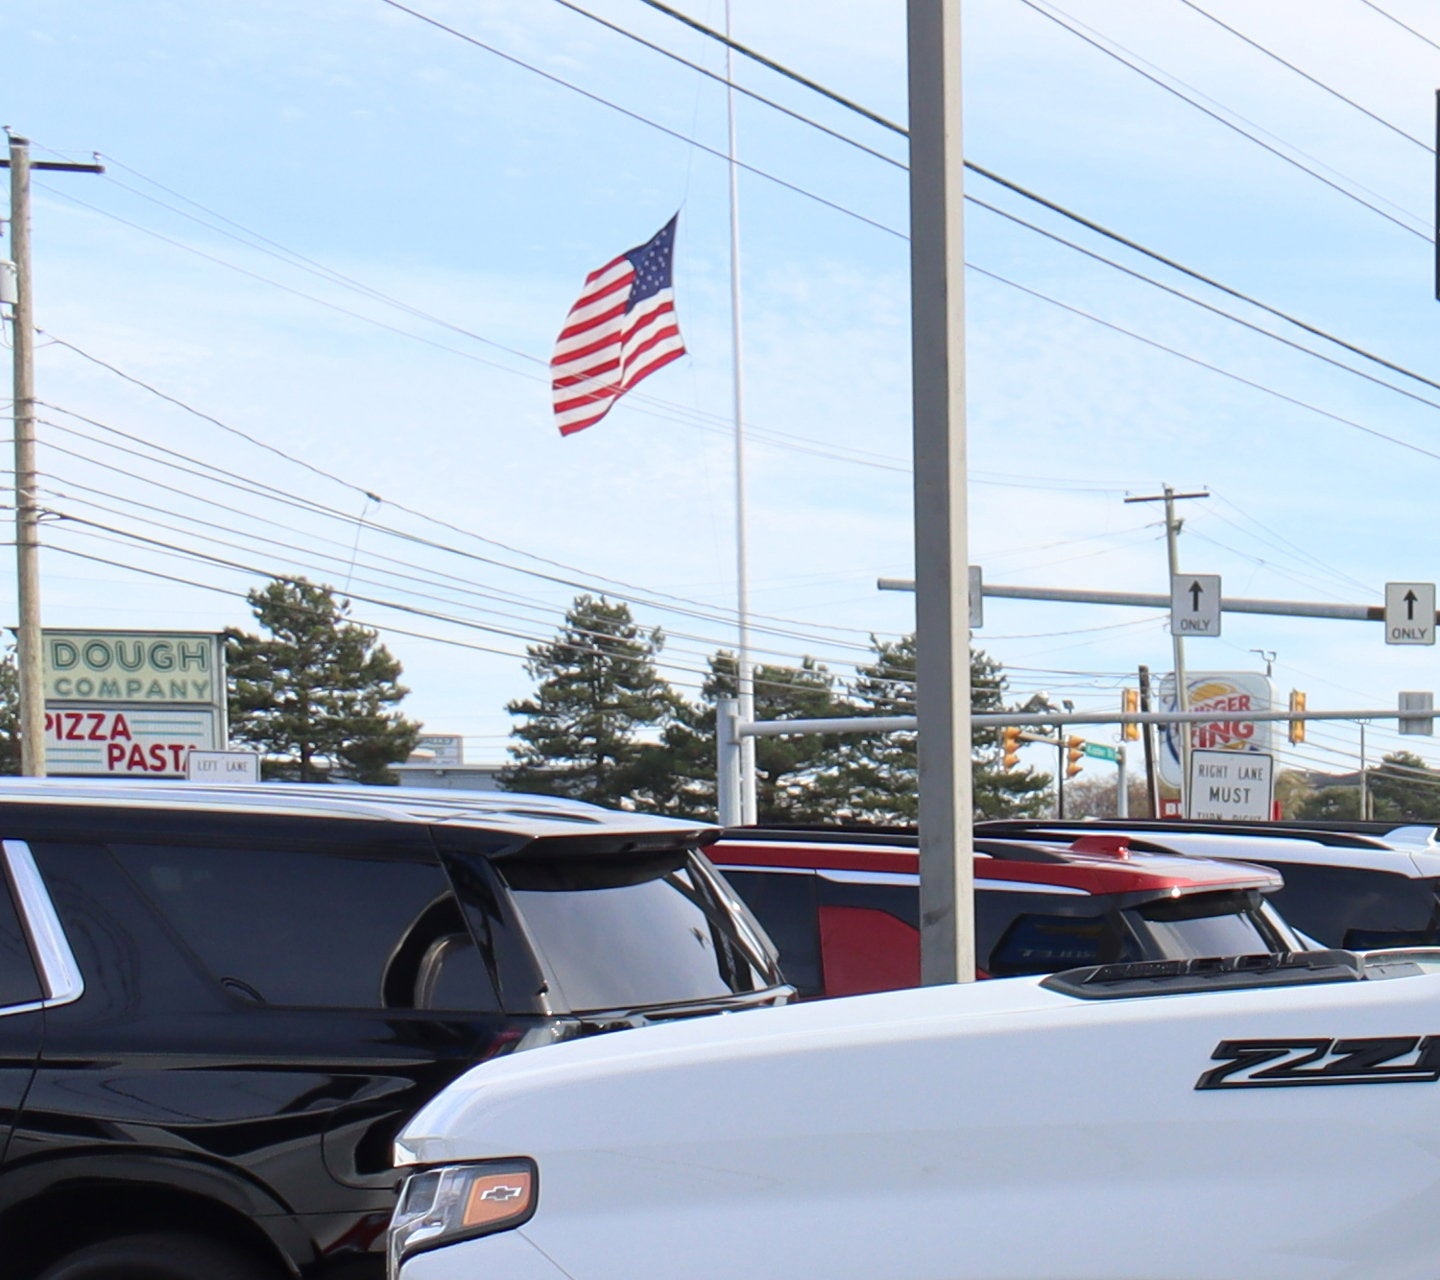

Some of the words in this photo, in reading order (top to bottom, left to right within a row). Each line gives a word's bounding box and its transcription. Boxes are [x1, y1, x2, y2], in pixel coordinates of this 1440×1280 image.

[1181, 619, 1211, 631] ONLY
[1392, 627, 1428, 640] ONLY
[51, 639, 210, 673] DOUGH
[54, 677, 210, 700] COMPANY
[107, 743, 196, 773] PAST
[197, 759, 218, 772] LEFT
[226, 761, 248, 773] LANE
[1198, 764, 1228, 779] RIGHT
[1238, 766, 1264, 781] LANE
[1209, 787, 1251, 804] MUST
